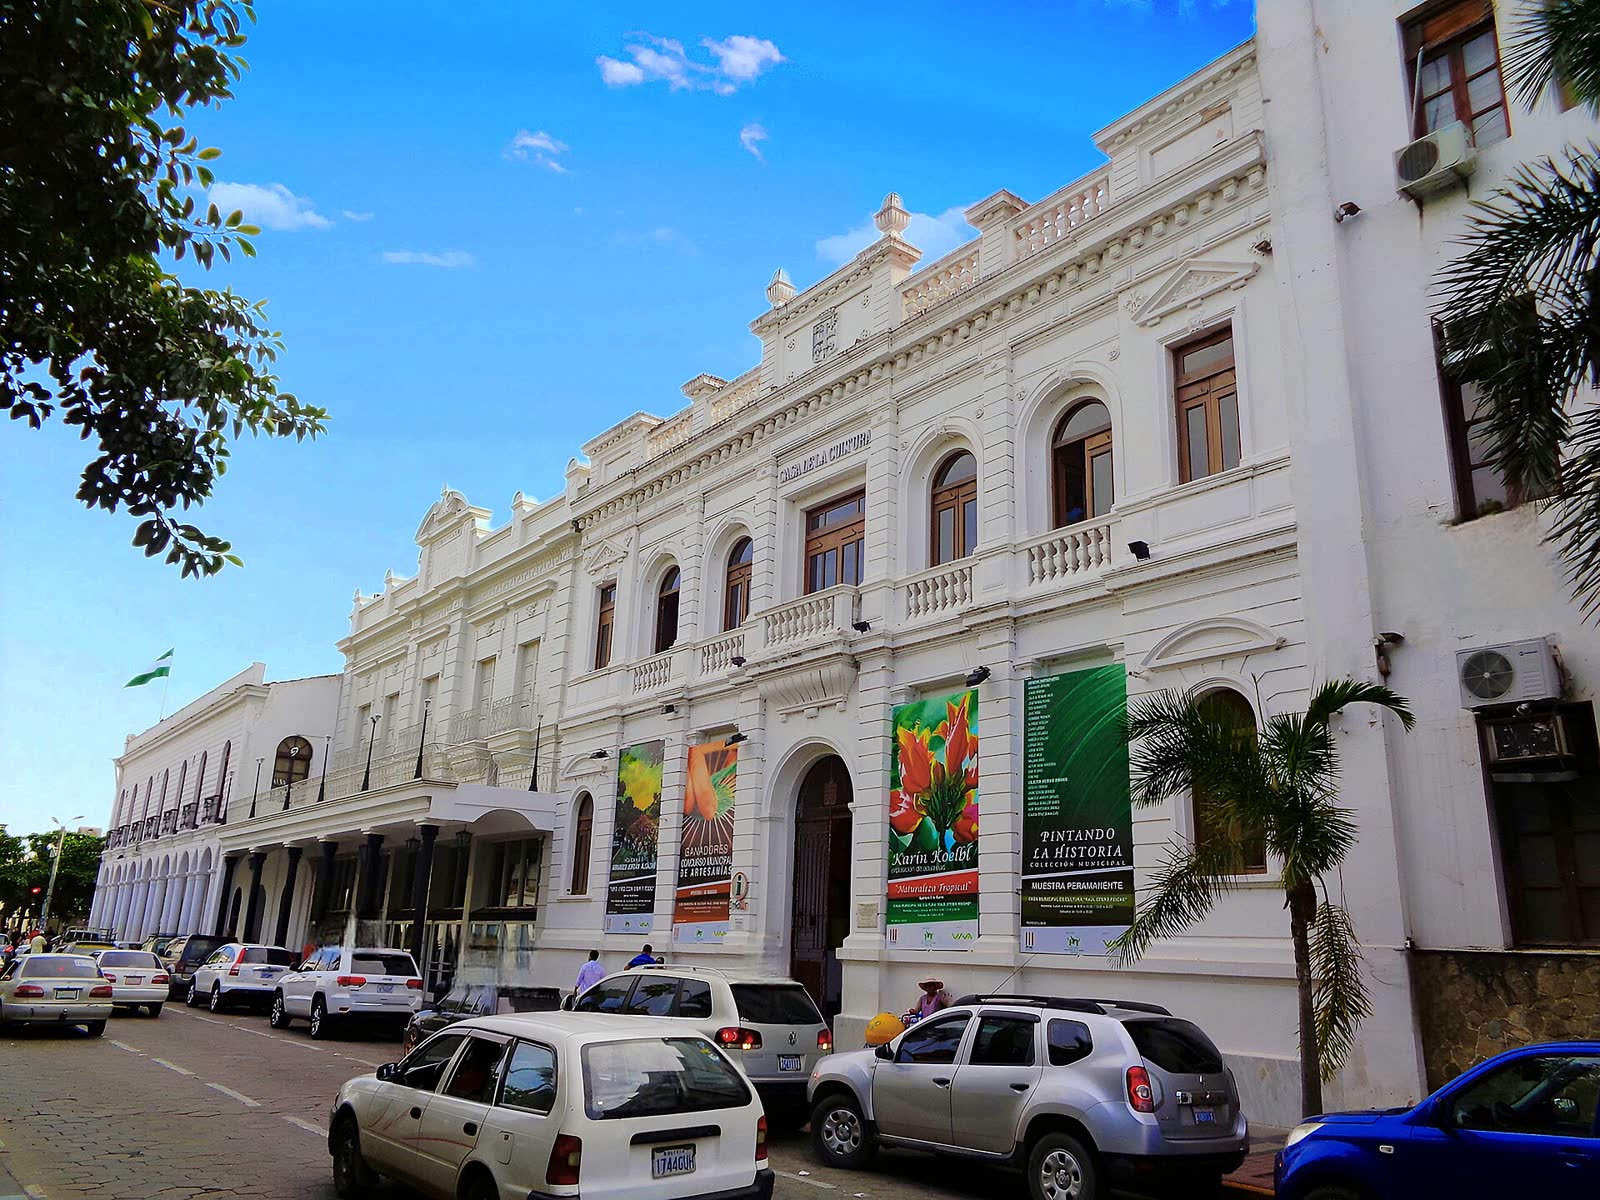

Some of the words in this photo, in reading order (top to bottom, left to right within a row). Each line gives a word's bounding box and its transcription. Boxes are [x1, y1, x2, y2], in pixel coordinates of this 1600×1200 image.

[779, 465, 802, 483] CASA
[802, 457, 814, 474] DE
[814, 450, 827, 468] LA
[829, 429, 872, 462] CULTURA
[1040, 827, 1116, 843] PINTANDO
[684, 844, 728, 856] GANADORES
[891, 851, 927, 866] Karin
[930, 845, 973, 864] Koelbl
[1033, 847, 1049, 860] LA
[1053, 844, 1123, 859] HISTORIA
[1029, 860, 1075, 868] COLECCIÓN
[1078, 860, 1126, 868] MUNICIPAL
[679, 868, 688, 878] DE
[689, 865, 734, 878] ARTESANÍAS
[1031, 881, 1066, 890] MUESTRA
[1066, 880, 1124, 890] PERAMANENTE
